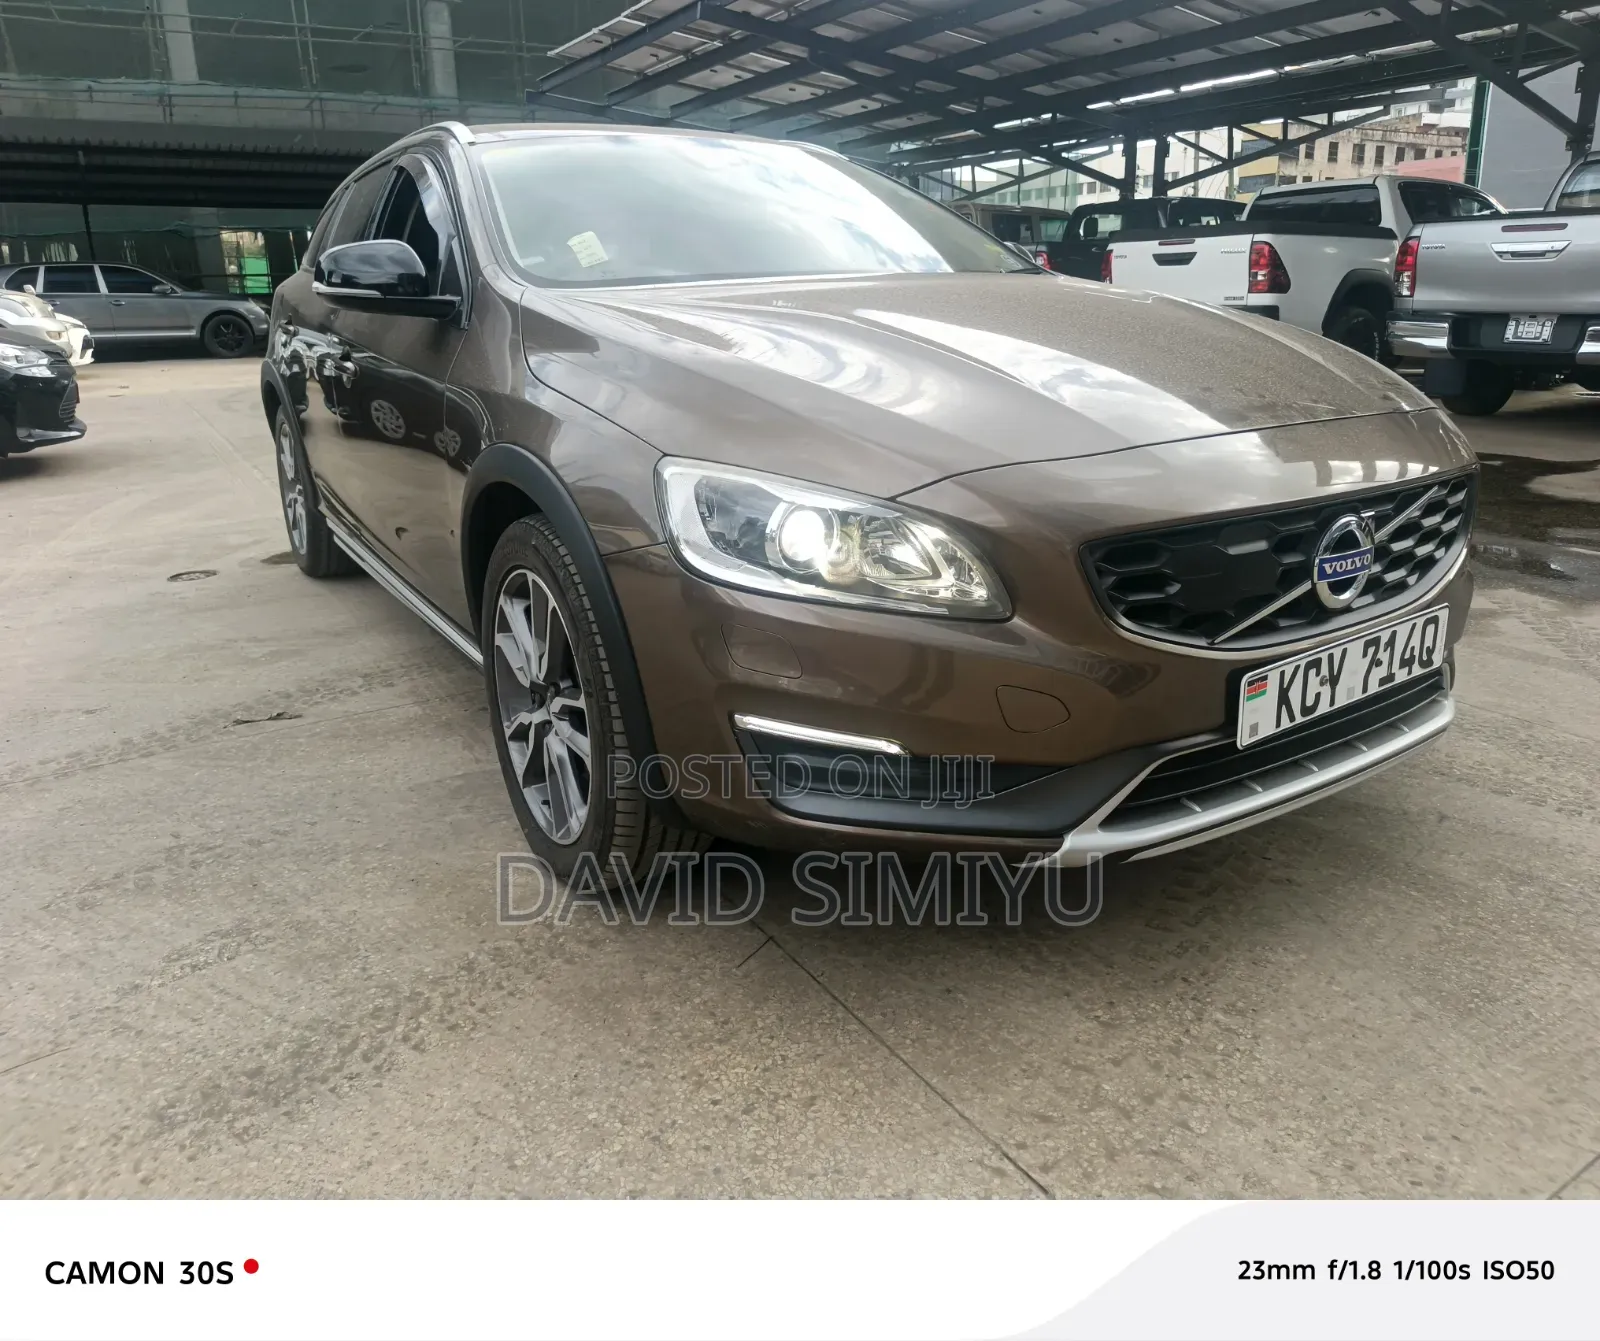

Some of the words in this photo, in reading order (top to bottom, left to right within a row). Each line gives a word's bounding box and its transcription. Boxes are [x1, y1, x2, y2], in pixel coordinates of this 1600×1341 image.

[1322, 554, 1371, 575] VOLVO
[1275, 647, 1348, 729] KCY
[1361, 614, 1440, 695] 714Q
